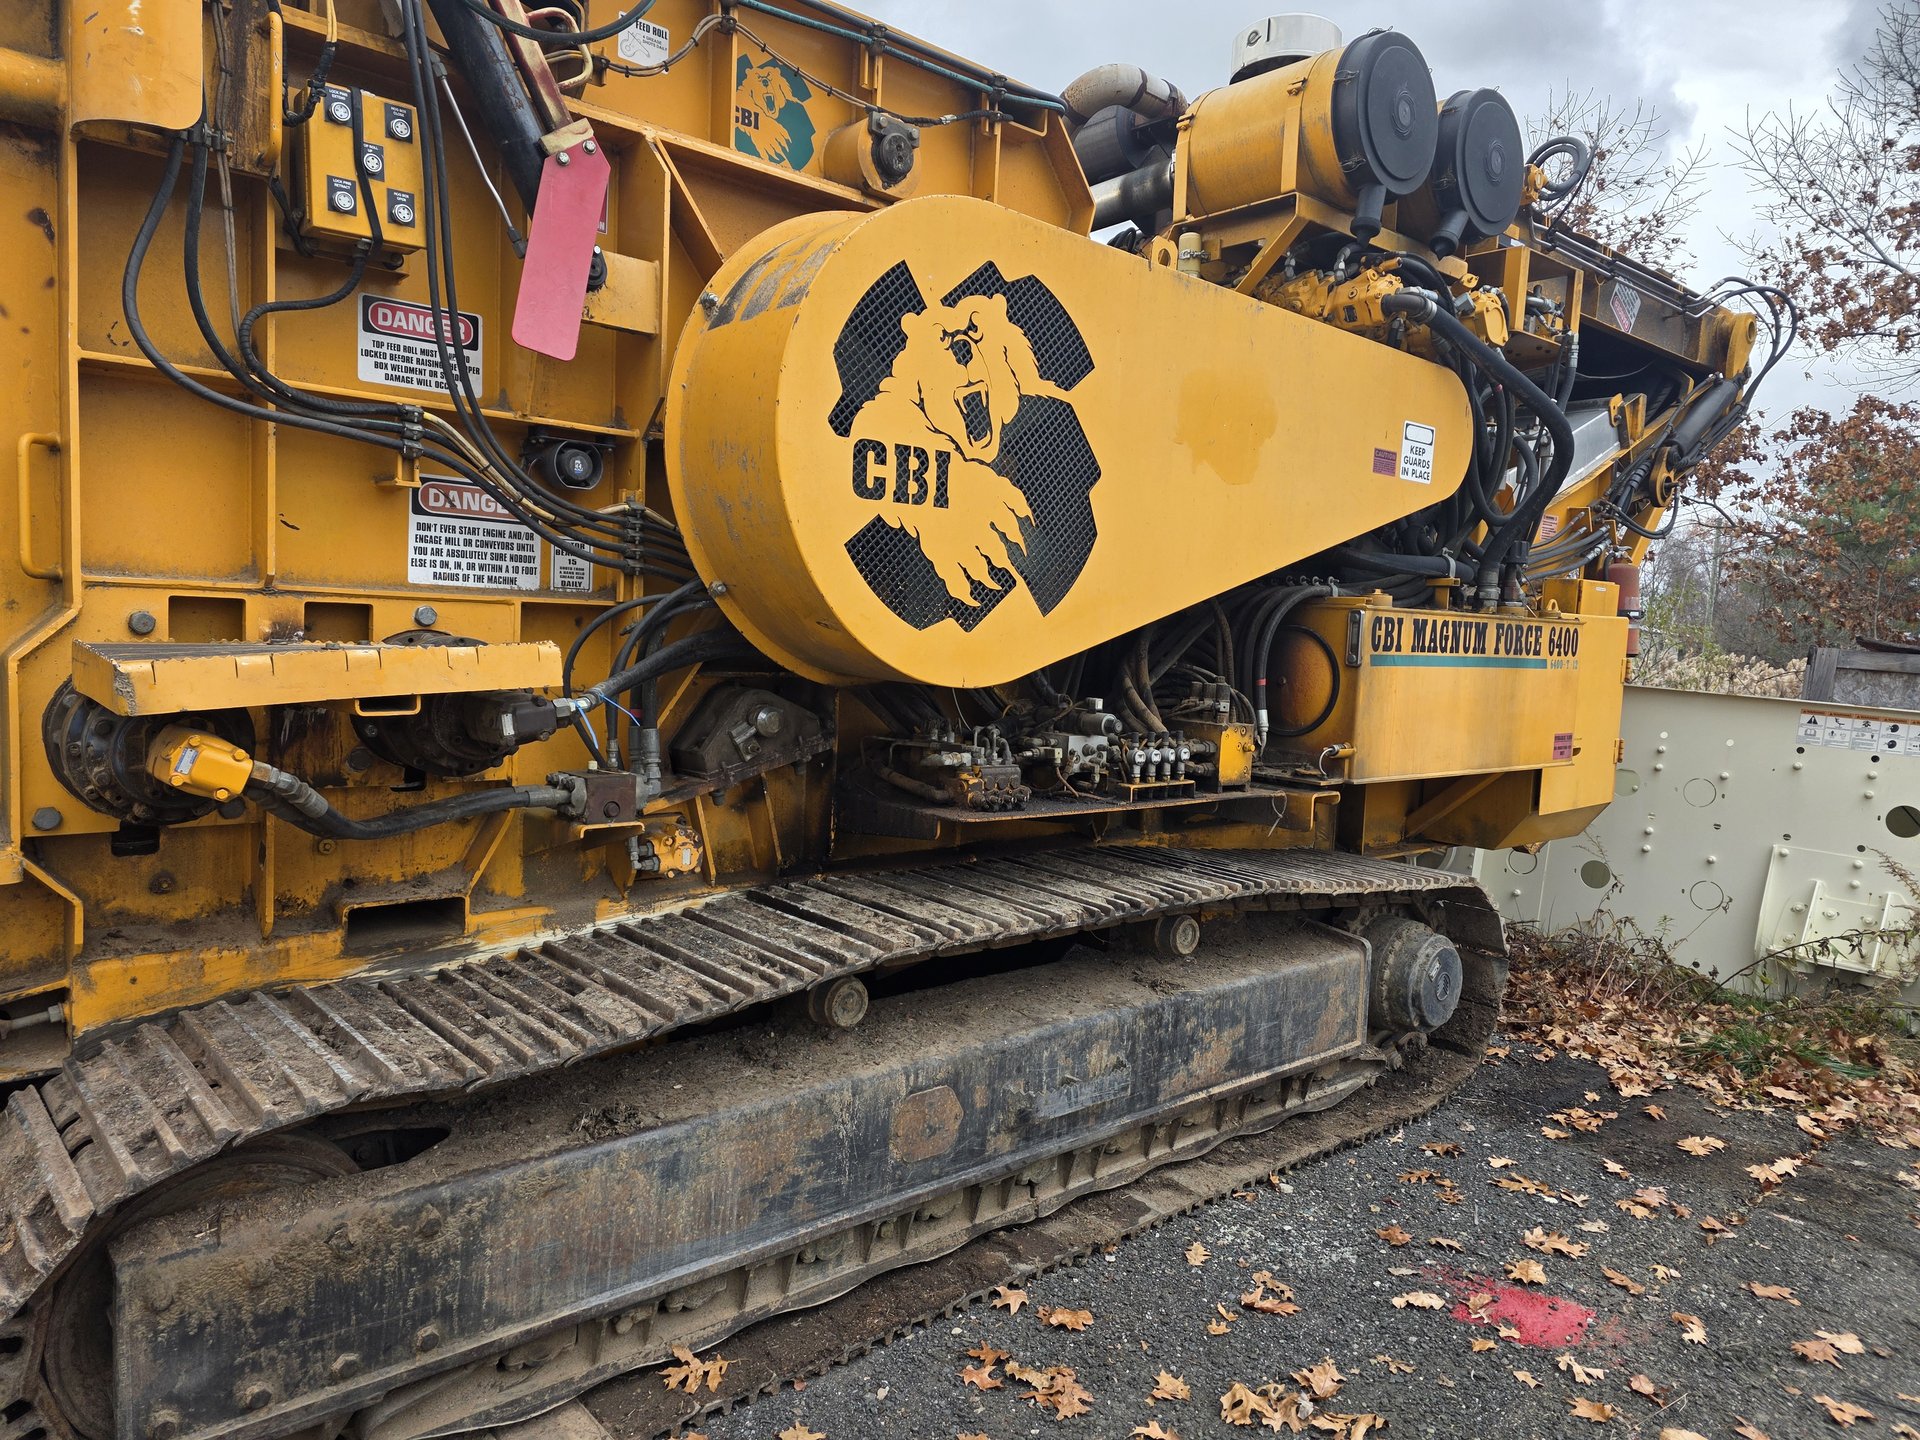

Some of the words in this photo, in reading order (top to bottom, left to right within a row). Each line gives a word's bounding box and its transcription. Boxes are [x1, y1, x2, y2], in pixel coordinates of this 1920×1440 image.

[636, 20, 650, 33] FEED
[653, 26, 668, 40] ROLL
[377, 307, 465, 340] DANGER
[372, 340, 384, 349] TOP
[386, 342, 401, 352] FEED
[403, 345, 418, 355] ROLL
[420, 348, 437, 358] MUST
[361, 348, 387, 359] LOCKED
[389, 353, 414, 364] BEFORE
[416, 357, 443, 369] RAISING
[374, 361, 389, 370] BOX
[391, 363, 427, 376] WELDMENT
[428, 369, 438, 379] OR
[385, 373, 414, 385] DAMAGE
[416, 377, 432, 388] WILL
[435, 381, 449, 390] OCC
[1410, 445, 1426, 456] KEEP
[1404, 456, 1430, 469] GUARDS
[852, 438, 951, 509] CBI
[1401, 467, 1409, 476] IN
[1412, 469, 1430, 480] PLACE
[416, 522, 437, 533] DON'T
[440, 524, 456, 534] EVER
[459, 526, 480, 536] START
[482, 528, 506, 538] ENGINE
[508, 531, 534, 541] AND/OR
[415, 534, 442, 545] ENGAGE
[445, 537, 461, 546] MILL
[463, 538, 472, 548] OR
[475, 540, 514, 551] CONVEYORS
[516, 543, 535, 553] UNTIL
[414, 546, 427, 556] YOU
[430, 548, 444, 557] ARE
[446, 549, 488, 560] ABSOLUTELY
[490, 552, 507, 562] SURE
[509, 554, 536, 564] NOBODY
[411, 558, 427, 568] ELSE
[430, 559, 437, 568] IS
[440, 560, 452, 571] ON,
[454, 561, 463, 572] IN,
[466, 562, 476, 571] OR
[478, 563, 503, 574] WITHIN
[504, 565, 509, 574] A
[512, 566, 519, 574] 10
[522, 566, 537, 576] FOOT
[433, 572, 460, 582] RADIUS
[462, 574, 470, 582] OF
[473, 574, 485, 583] THE
[487, 575, 517, 586] MACHINE
[1371, 616, 1404, 652] CBI
[1411, 618, 1488, 655] MAGNUM
[1494, 623, 1543, 656] FORCE
[1548, 626, 1578, 657] 6400
